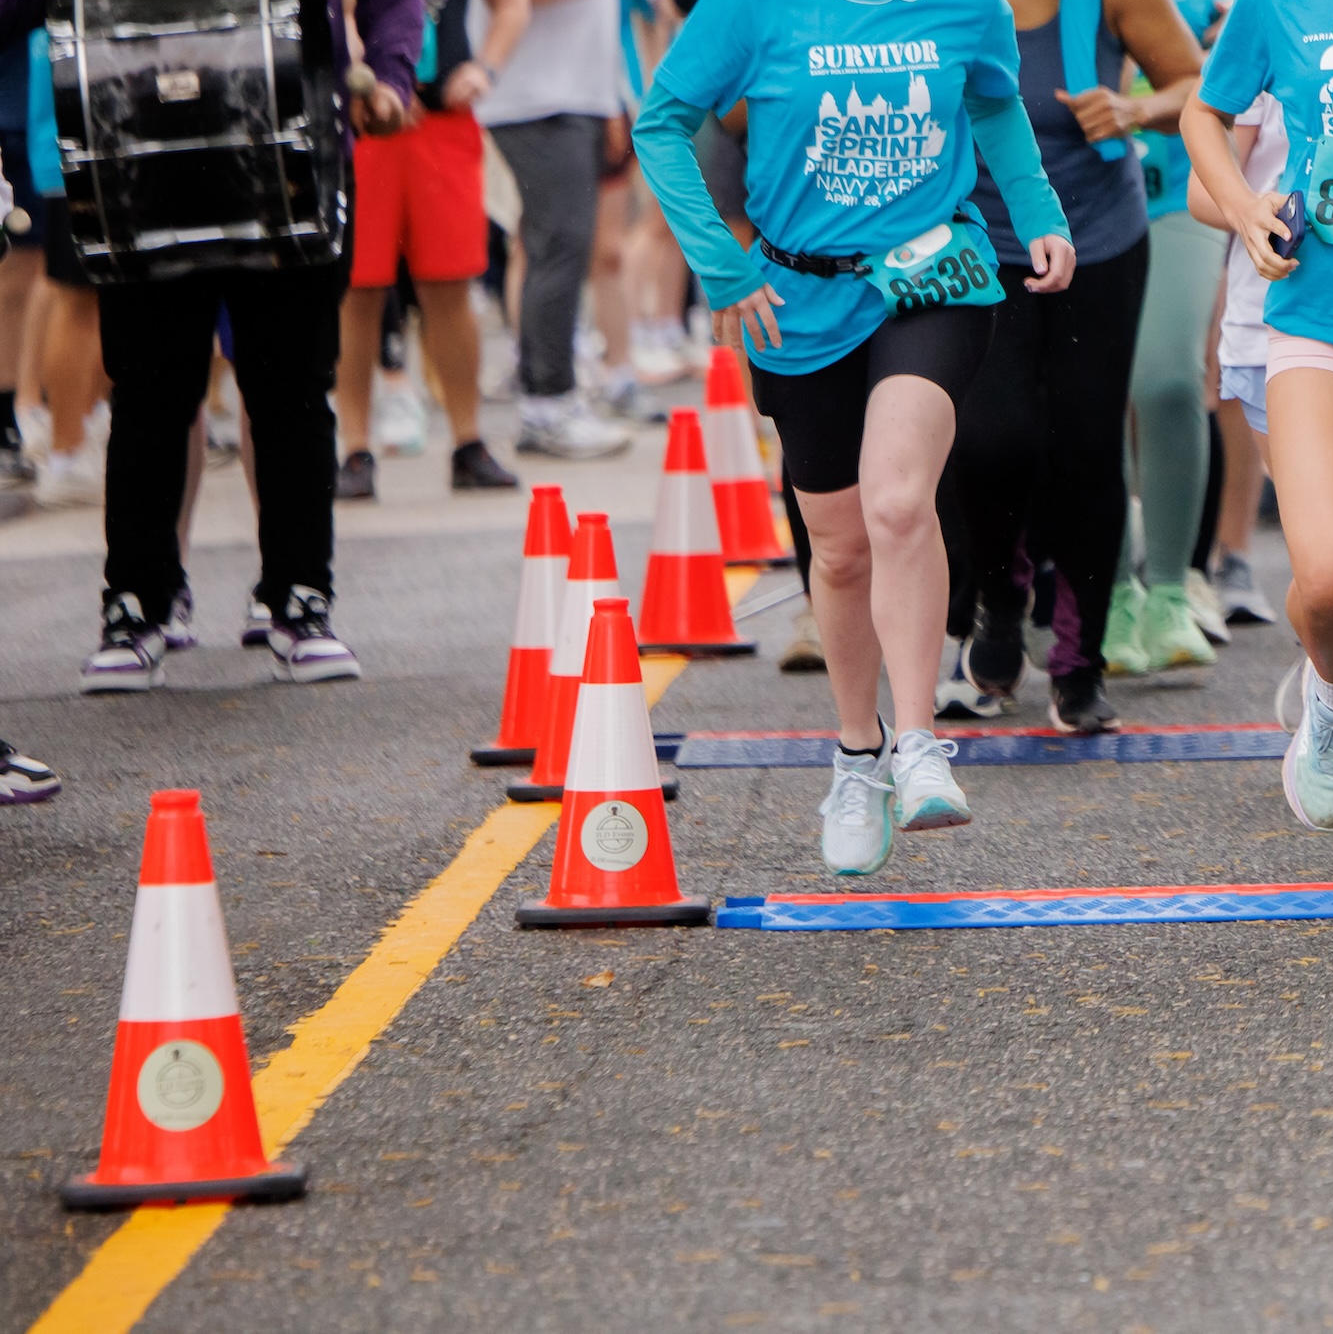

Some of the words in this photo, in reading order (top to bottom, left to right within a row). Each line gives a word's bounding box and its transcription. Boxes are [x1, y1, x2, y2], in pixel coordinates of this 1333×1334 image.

[808, 40, 940, 69] SURVIVOR
[821, 113, 930, 139] SANDY
[821, 135, 929, 158] SPRINT
[816, 173, 869, 197] NAVY
[889, 248, 990, 315] 8536
